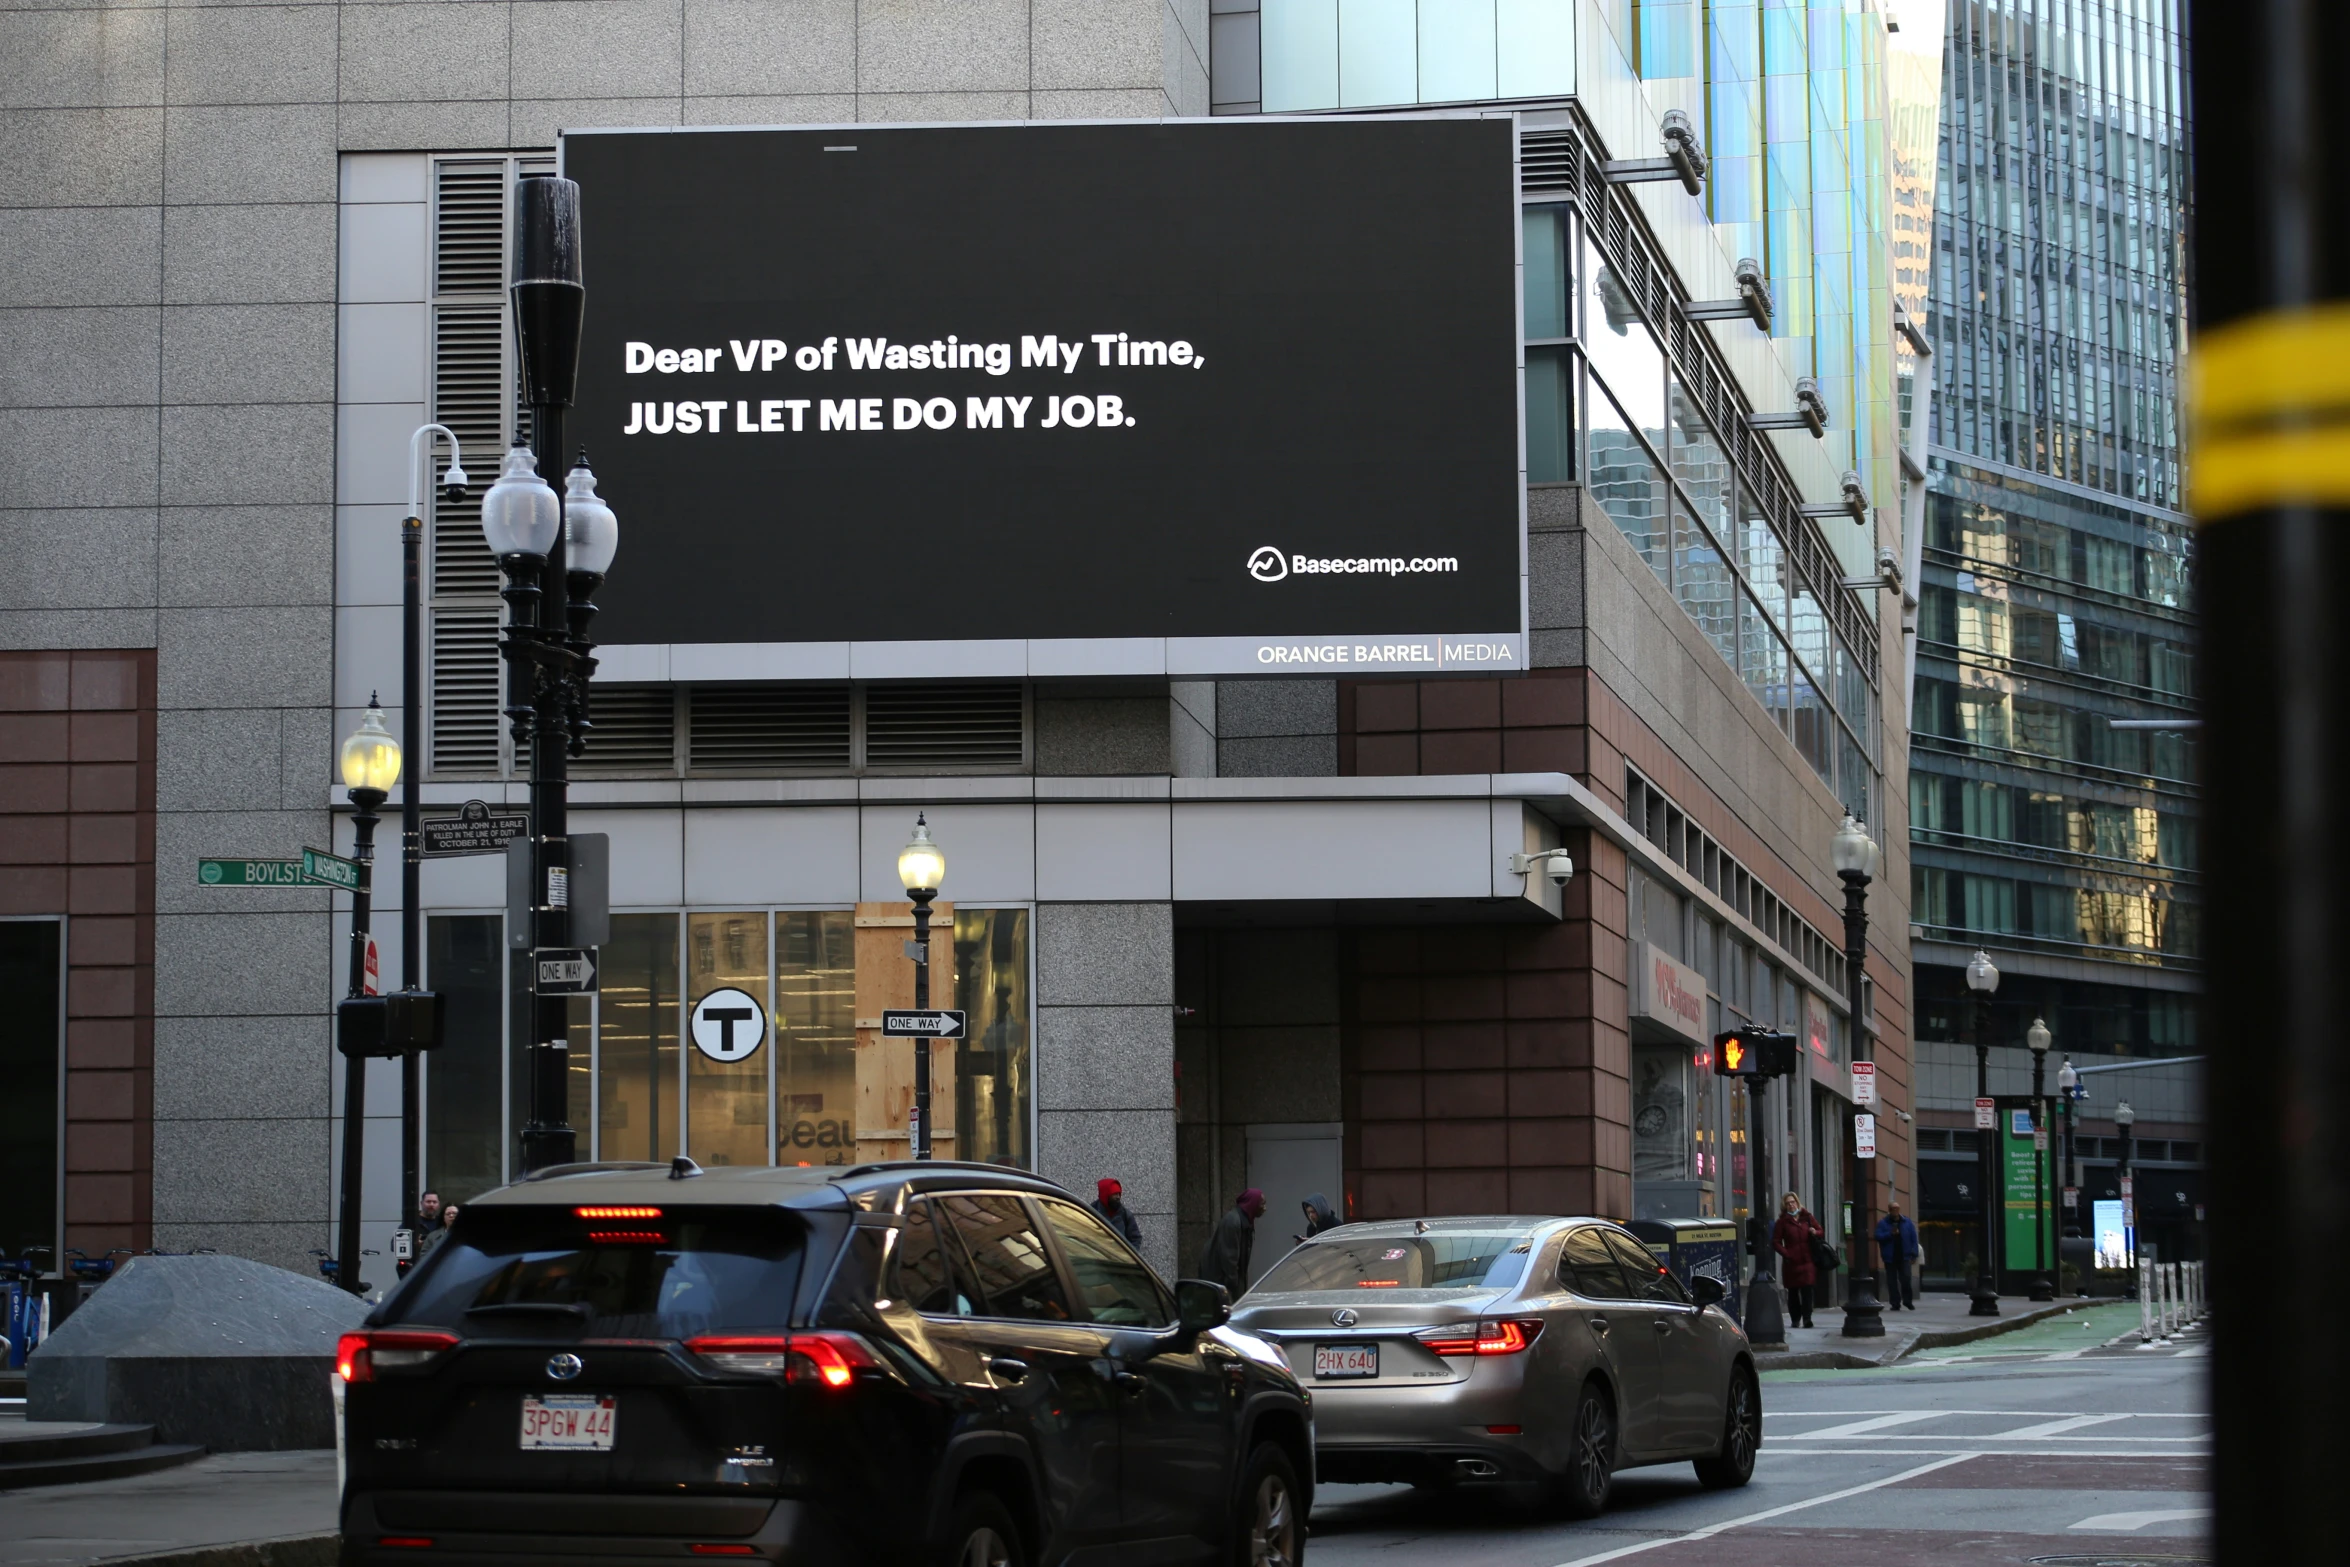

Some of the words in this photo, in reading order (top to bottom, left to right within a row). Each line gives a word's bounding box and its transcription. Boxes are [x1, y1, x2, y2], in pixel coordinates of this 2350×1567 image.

[625, 341, 722, 374] Dear
[729, 339, 788, 371] VP
[795, 336, 838, 371] of
[845, 334, 1011, 376] Wasting
[1021, 335, 1084, 374] My
[1091, 332, 1205, 370] Time,
[624, 400, 728, 435] JUST
[737, 399, 811, 433] LET
[820, 398, 884, 432] ME
[893, 396, 957, 430] DO
[966, 395, 1033, 429] MY
[1041, 394, 1136, 428] JOB.
[1292, 554, 1459, 577] Basecamp.com
[1257, 645, 1349, 664] ORANGE
[1354, 644, 1434, 662] BARREL
[1444, 643, 1513, 661] MEDIA
[426, 823, 468, 832] PATROLMAN
[469, 822, 489, 830] JOHN
[491, 821, 498, 829] J.
[500, 820, 524, 828] EARLE
[476, 830, 488, 838] LINE
[500, 829, 516, 837] DUTY
[439, 838, 478, 848] OCTOBER
[245, 862, 317, 883] BOYLST
[314, 855, 351, 884] WASHINGTON
[541, 962, 561, 980] ONE
[565, 961, 582, 980] WAY
[702, 1007, 753, 1051] T
[889, 1017, 913, 1029] ONE
[918, 1017, 942, 1029] WAY
[1853, 1065, 1862, 1074] TOW
[1862, 1065, 1873, 1074] ZONE
[1317, 1352, 1344, 1369] 2HX
[524, 1409, 579, 1436] 3PGW
[584, 1410, 611, 1437] 44
